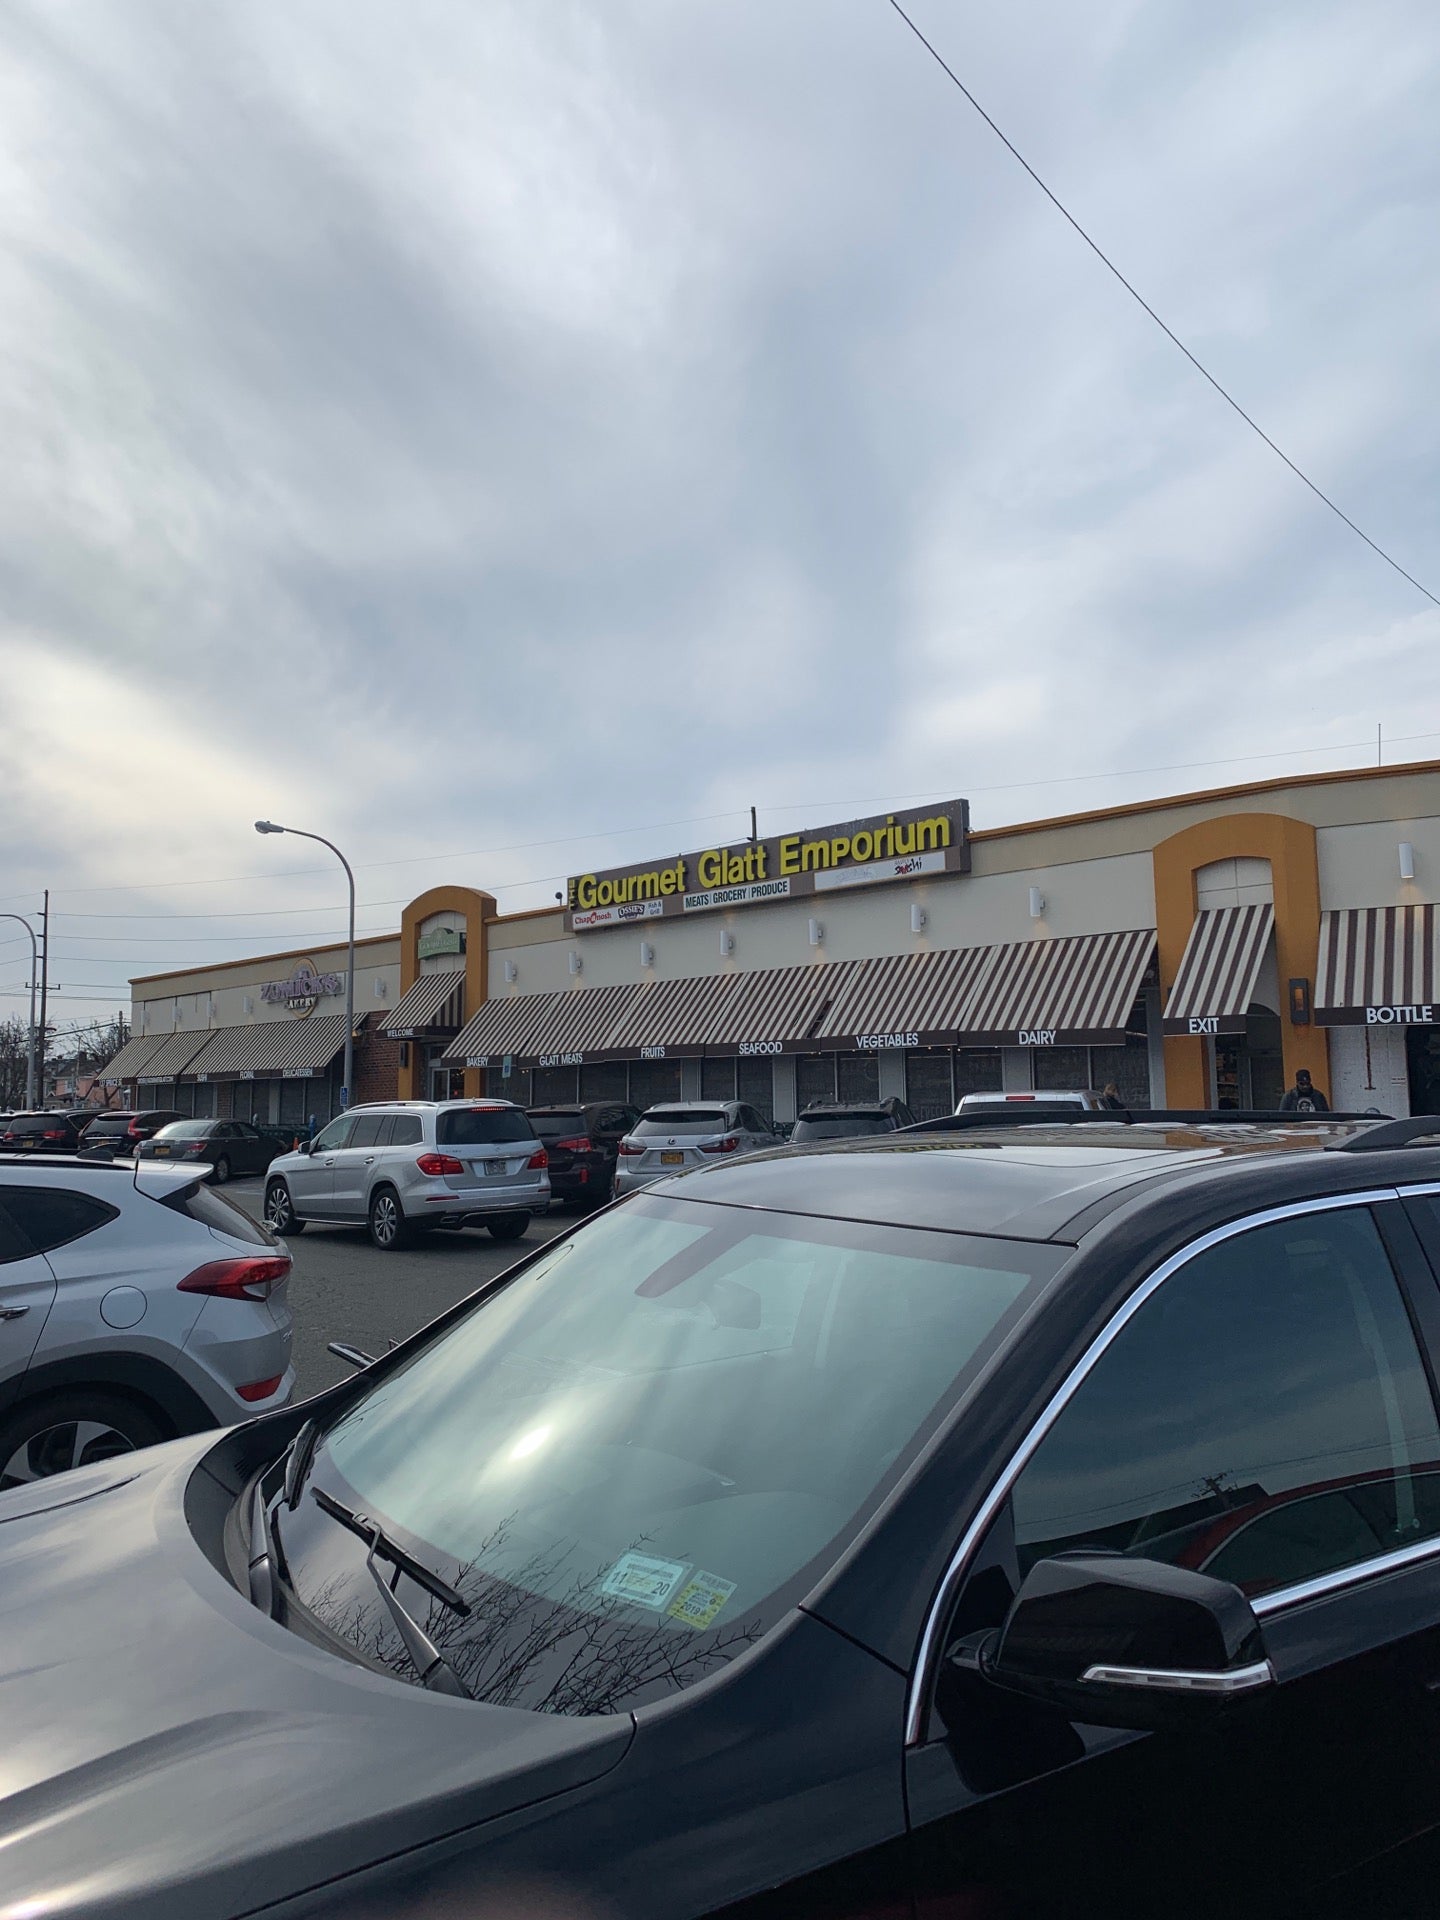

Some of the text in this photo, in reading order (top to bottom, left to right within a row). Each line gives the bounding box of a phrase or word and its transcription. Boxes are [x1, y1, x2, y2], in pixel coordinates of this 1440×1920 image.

[578, 815, 949, 909] Gourmet Glatt Emporium
[685, 880, 788, 909] MEATS GROCERY PRODUCE
[284, 996, 317, 1009] AKERY
[1366, 1006, 1433, 1024] BOTTLE
[386, 1028, 415, 1038] WELCOME
[1188, 1017, 1220, 1034] EXIT
[856, 1033, 919, 1049] VEGETABLES
[1018, 1030, 1057, 1046] DAIRY
[640, 1046, 666, 1059] FRUITS
[738, 1041, 783, 1056] SEAFOOD
[466, 1056, 490, 1067] BAKERY
[539, 1053, 583, 1067] GLATT MEATS
[651, 1581, 671, 1597] 20
